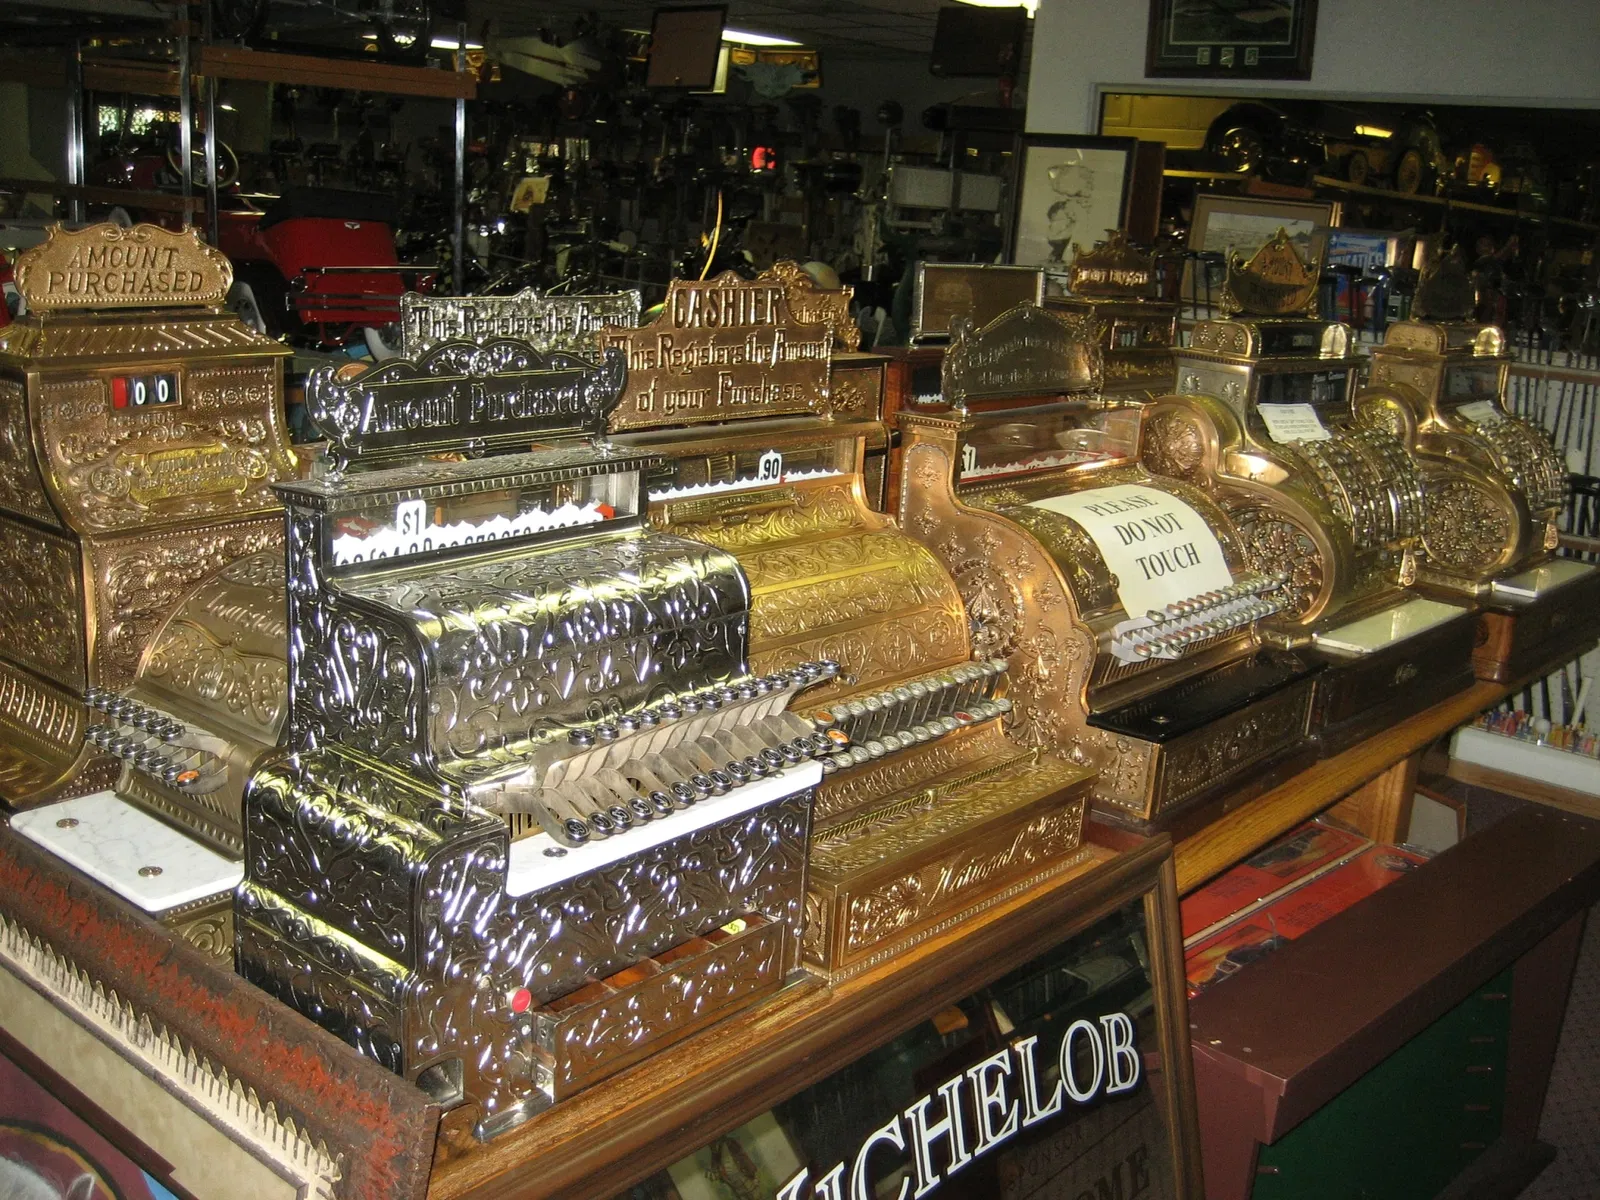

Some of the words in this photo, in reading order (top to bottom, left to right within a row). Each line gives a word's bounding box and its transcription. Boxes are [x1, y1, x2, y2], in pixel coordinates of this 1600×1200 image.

[68, 246, 180, 269] AMOUNT
[47, 271, 203, 295] PURCHASED
[657, 332, 743, 376] Registers
[745, 329, 772, 363] the
[769, 328, 833, 370] Amount
[362, 385, 461, 435] Amount
[636, 376, 659, 413] of
[663, 387, 711, 416] your
[402, 507, 420, 536] $1
[1083, 494, 1158, 517] PLEASE
[1113, 521, 1146, 546] DO
[1142, 512, 1184, 538] NOT
[1136, 542, 1202, 581] TOUCH
[776, 1012, 1140, 1200] CHELOB
